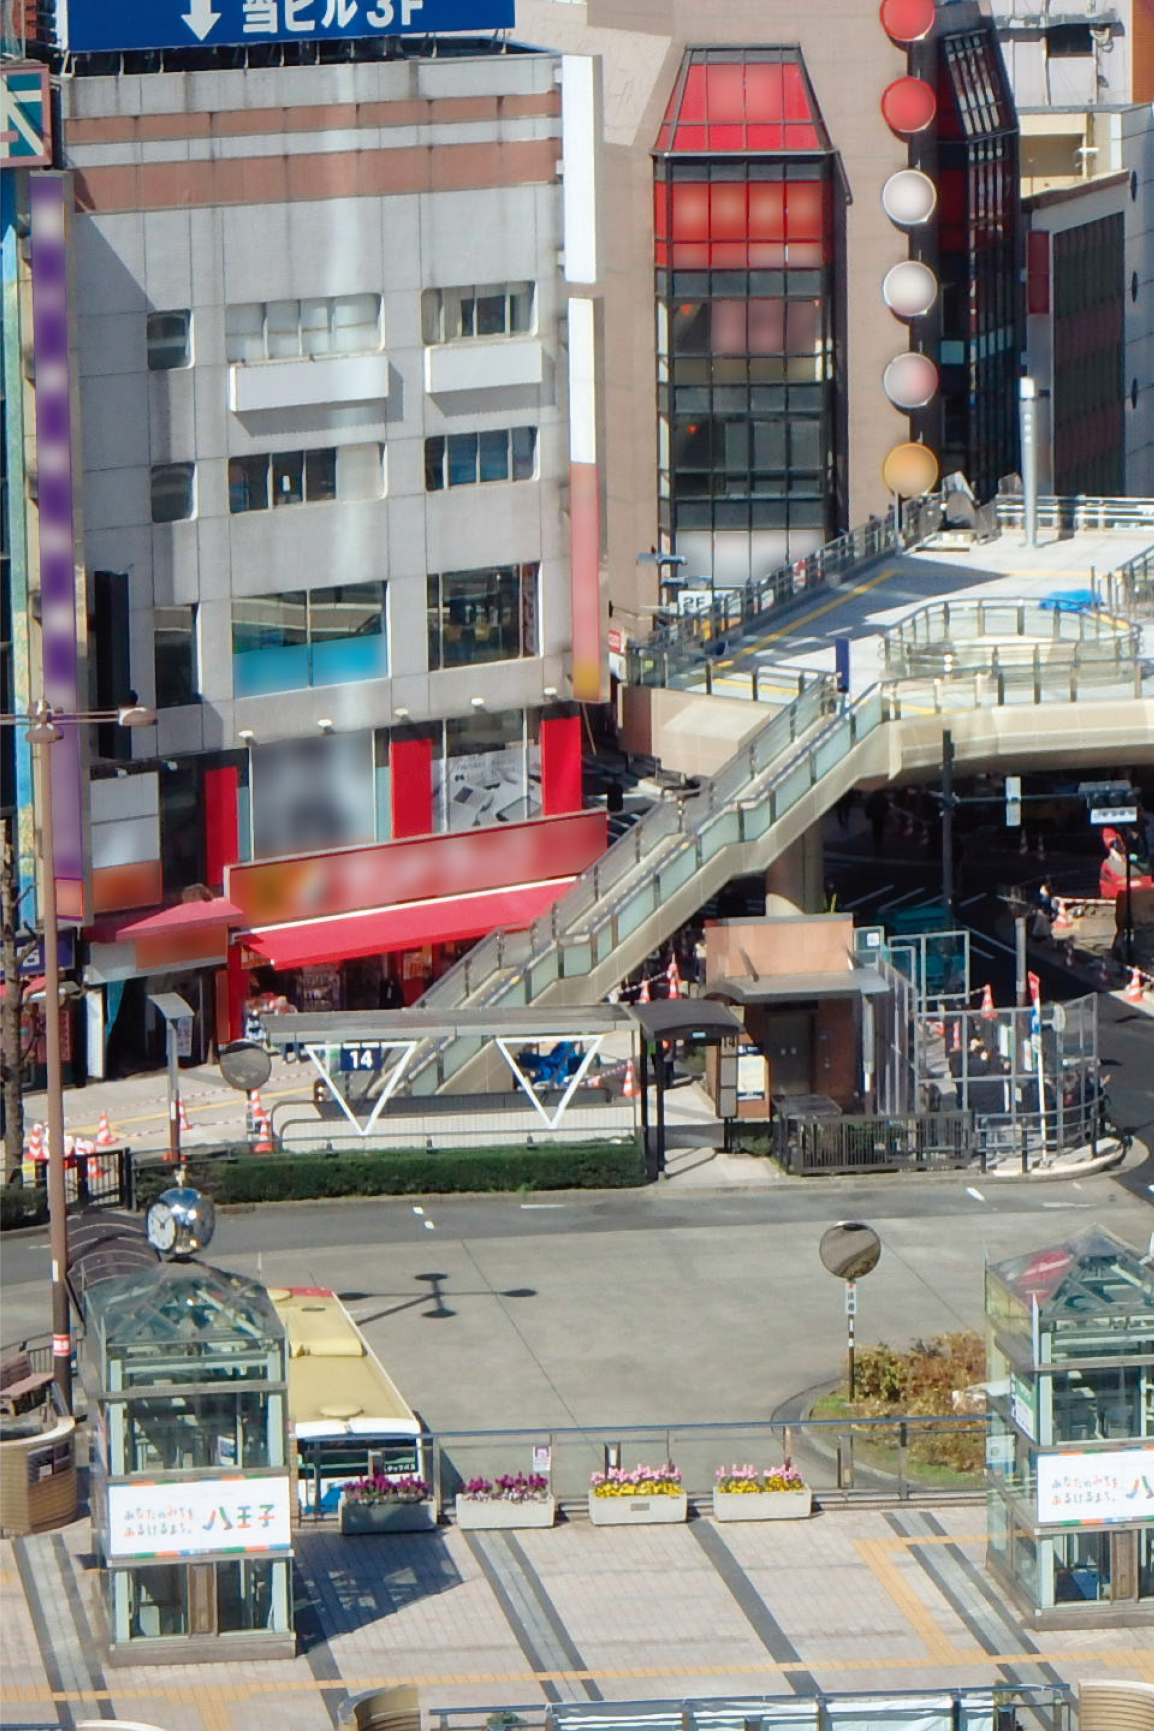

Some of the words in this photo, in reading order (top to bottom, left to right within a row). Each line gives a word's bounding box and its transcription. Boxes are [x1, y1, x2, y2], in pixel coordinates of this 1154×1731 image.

[682, 595, 706, 608] 2F
[349, 1050, 373, 1069] 14
[202, 1503, 275, 1531] 八王子
